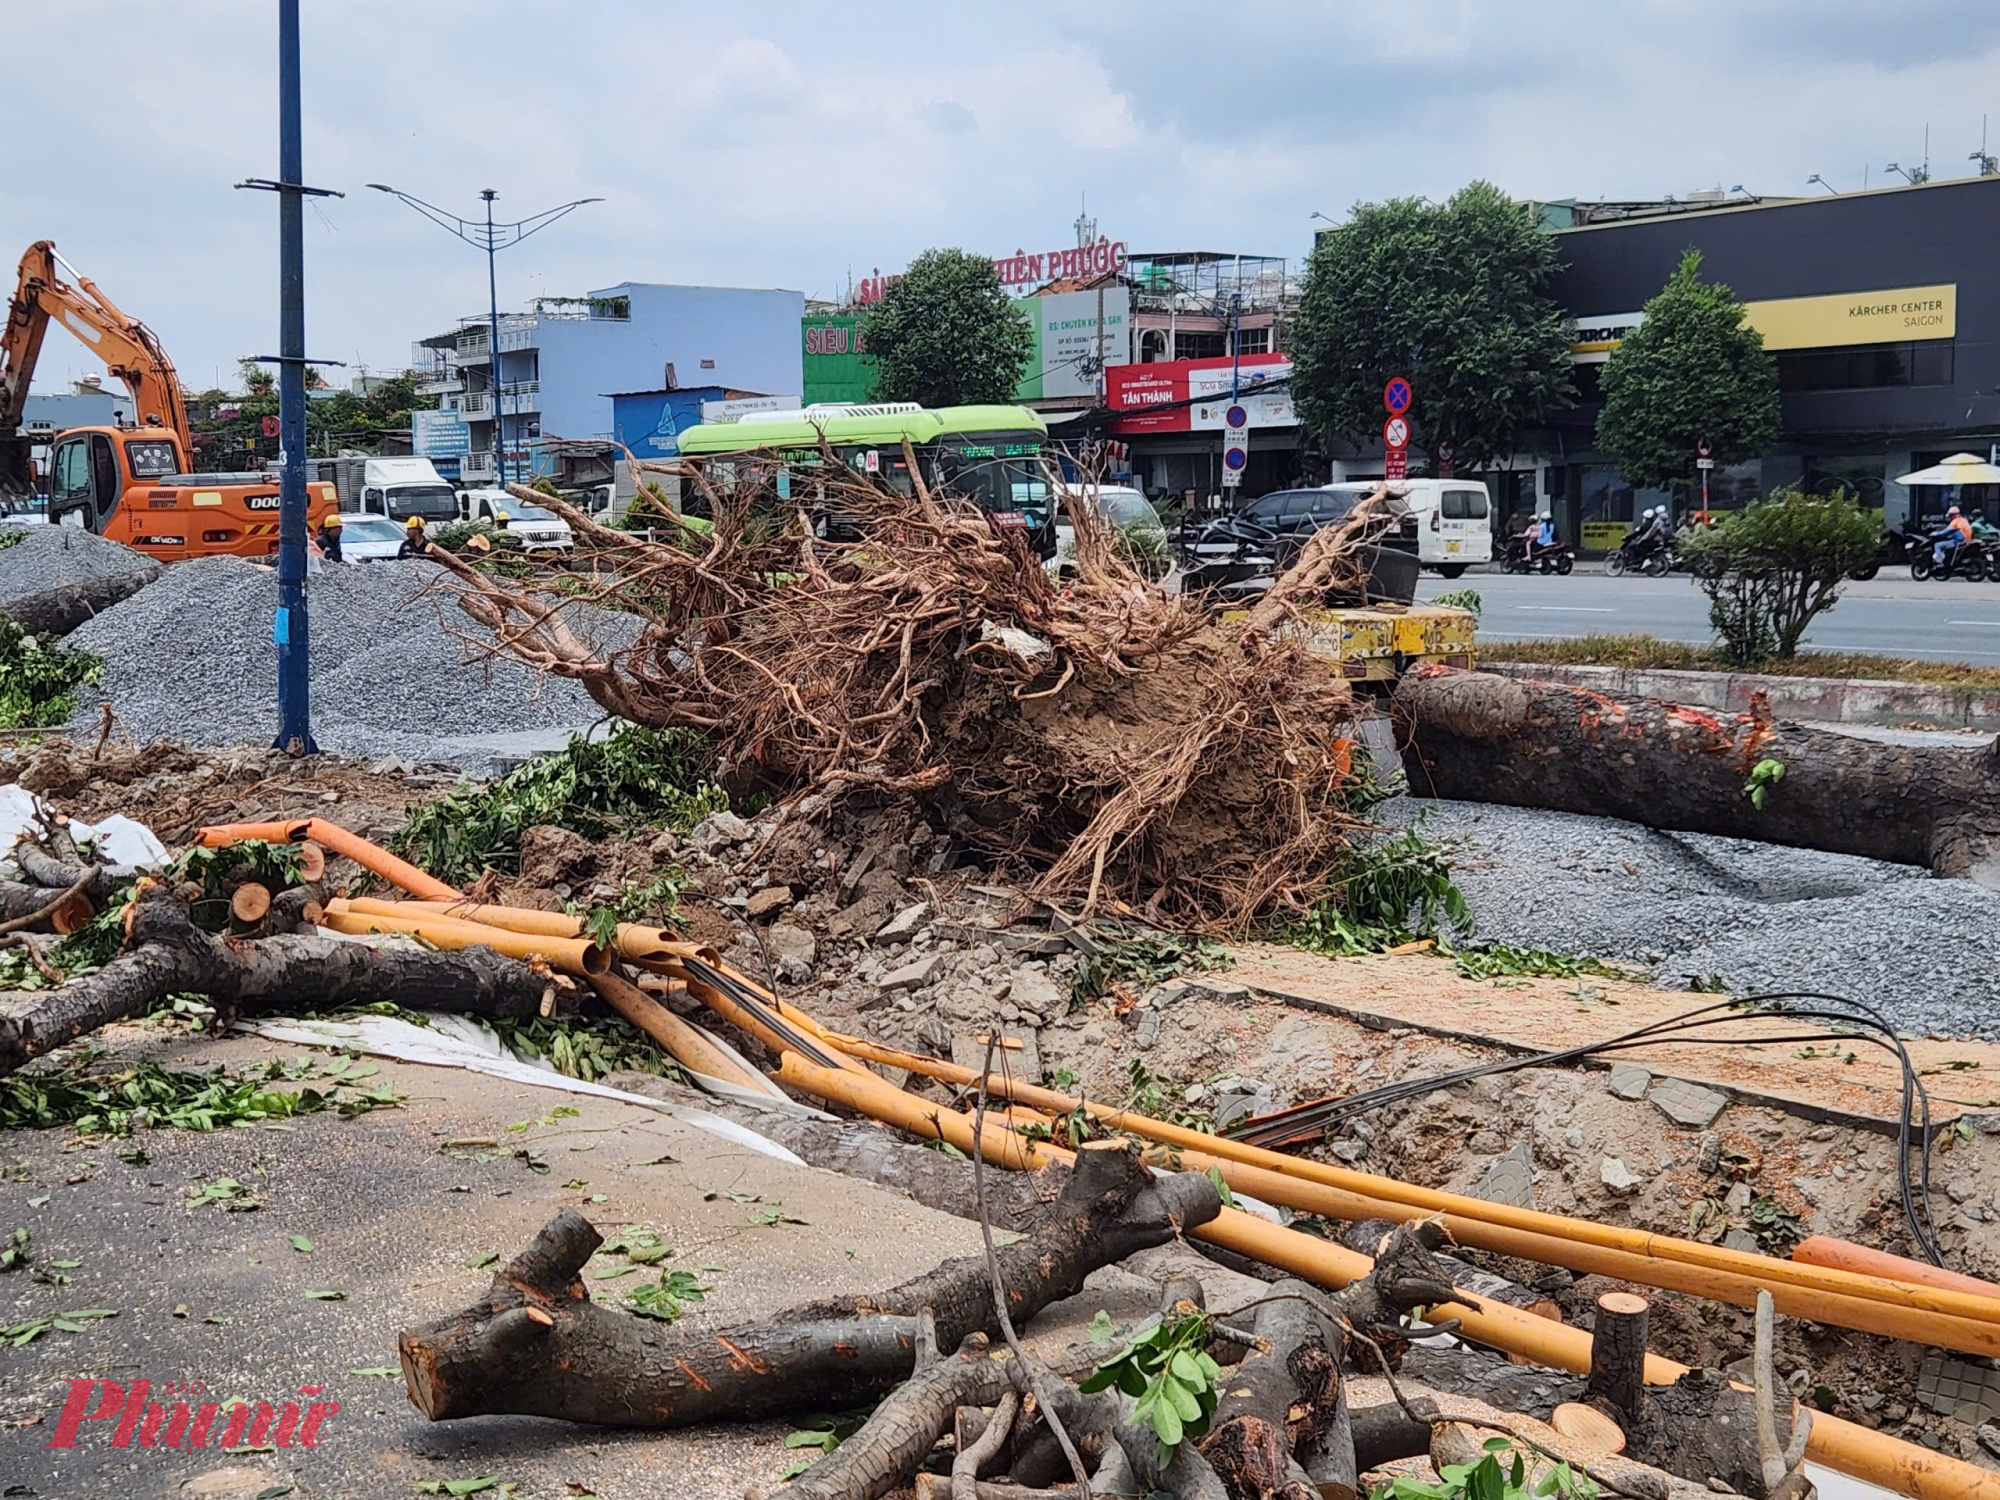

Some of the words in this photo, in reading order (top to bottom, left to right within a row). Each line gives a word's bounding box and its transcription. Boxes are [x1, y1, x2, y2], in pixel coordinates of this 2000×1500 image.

[992, 248, 1044, 293] HIỆN
[1047, 235, 1126, 280] PHƯỚC
[1849, 304, 1898, 318] KÄRCHER
[1901, 300, 1943, 313] CENTER
[1088, 317, 1107, 328] KHA
[1904, 315, 1943, 328] SAIGON
[806, 321, 848, 355] SIÊU
[1200, 381, 1216, 390] SCG
[1122, 391, 1140, 405] TÂN
[1141, 389, 1173, 403] THÀNH
[867, 453, 877, 468] 04
[251, 496, 280, 509] DOO
